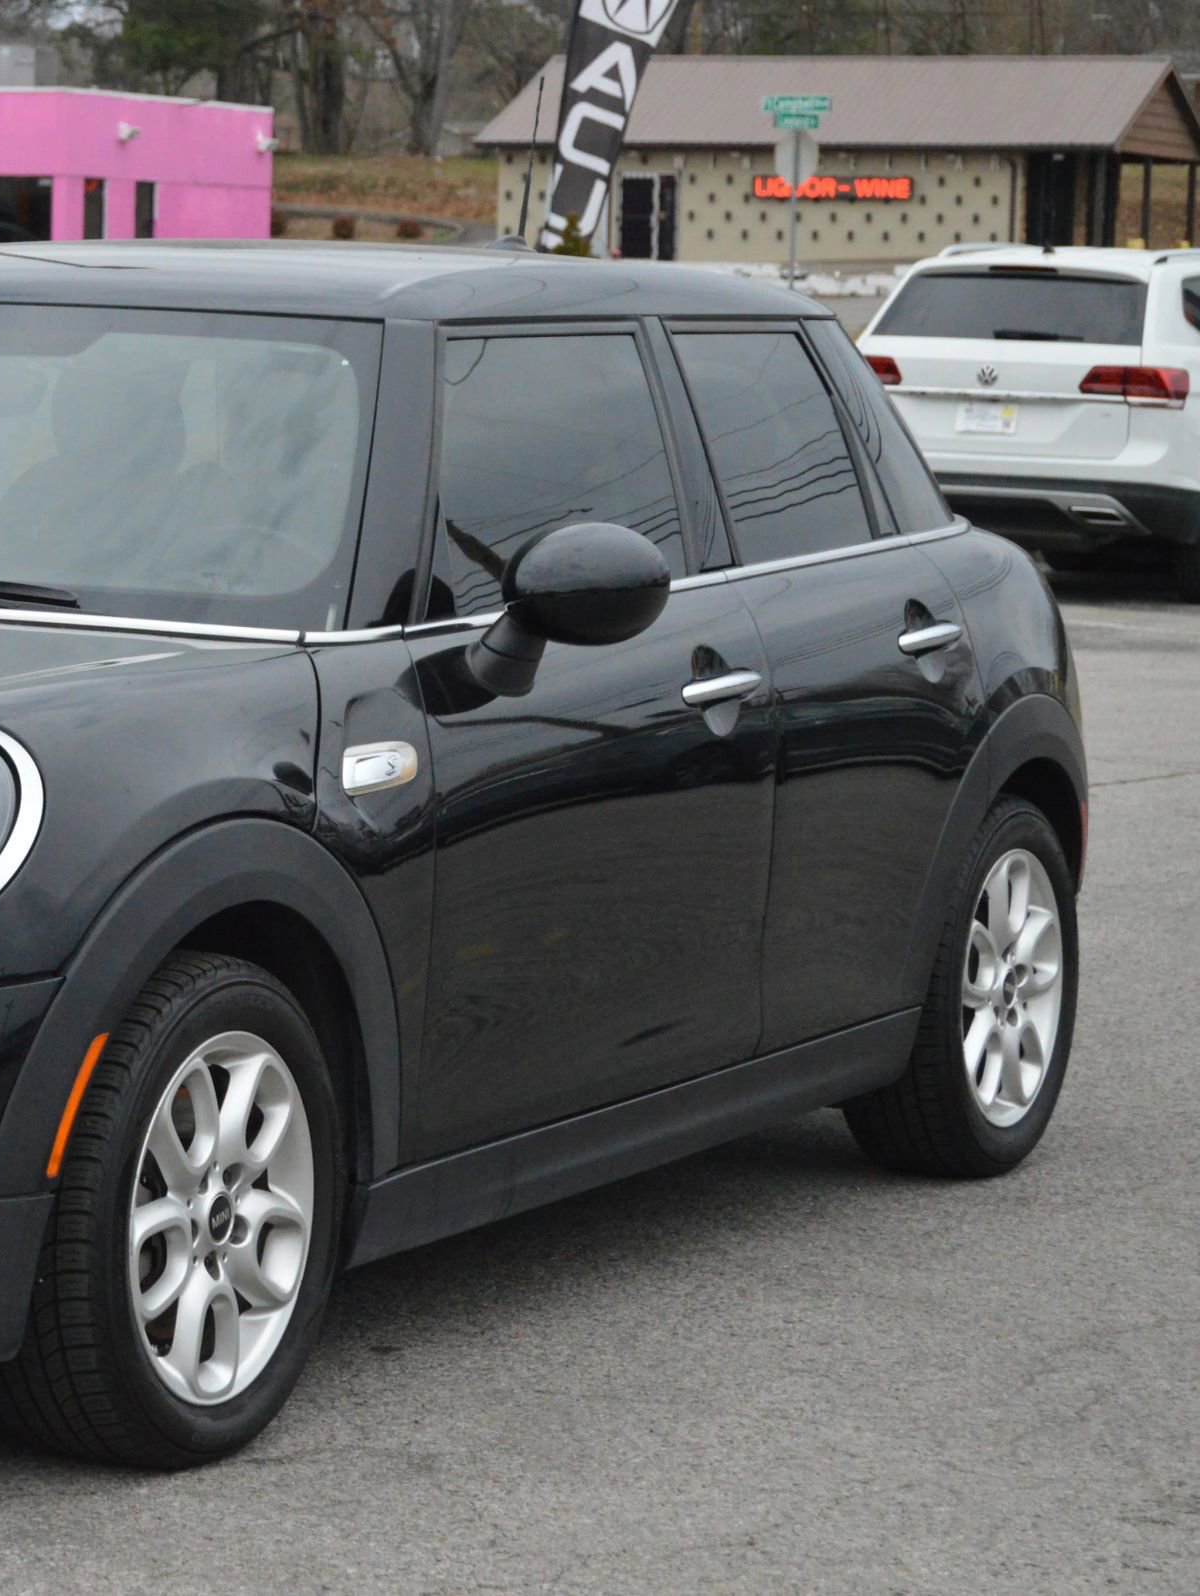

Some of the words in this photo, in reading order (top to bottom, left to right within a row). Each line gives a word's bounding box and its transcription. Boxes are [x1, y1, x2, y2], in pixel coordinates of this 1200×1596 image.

[541, 40, 637, 249] ACU
[853, 178, 910, 198] WINE
[211, 1207, 231, 1231] MINI
